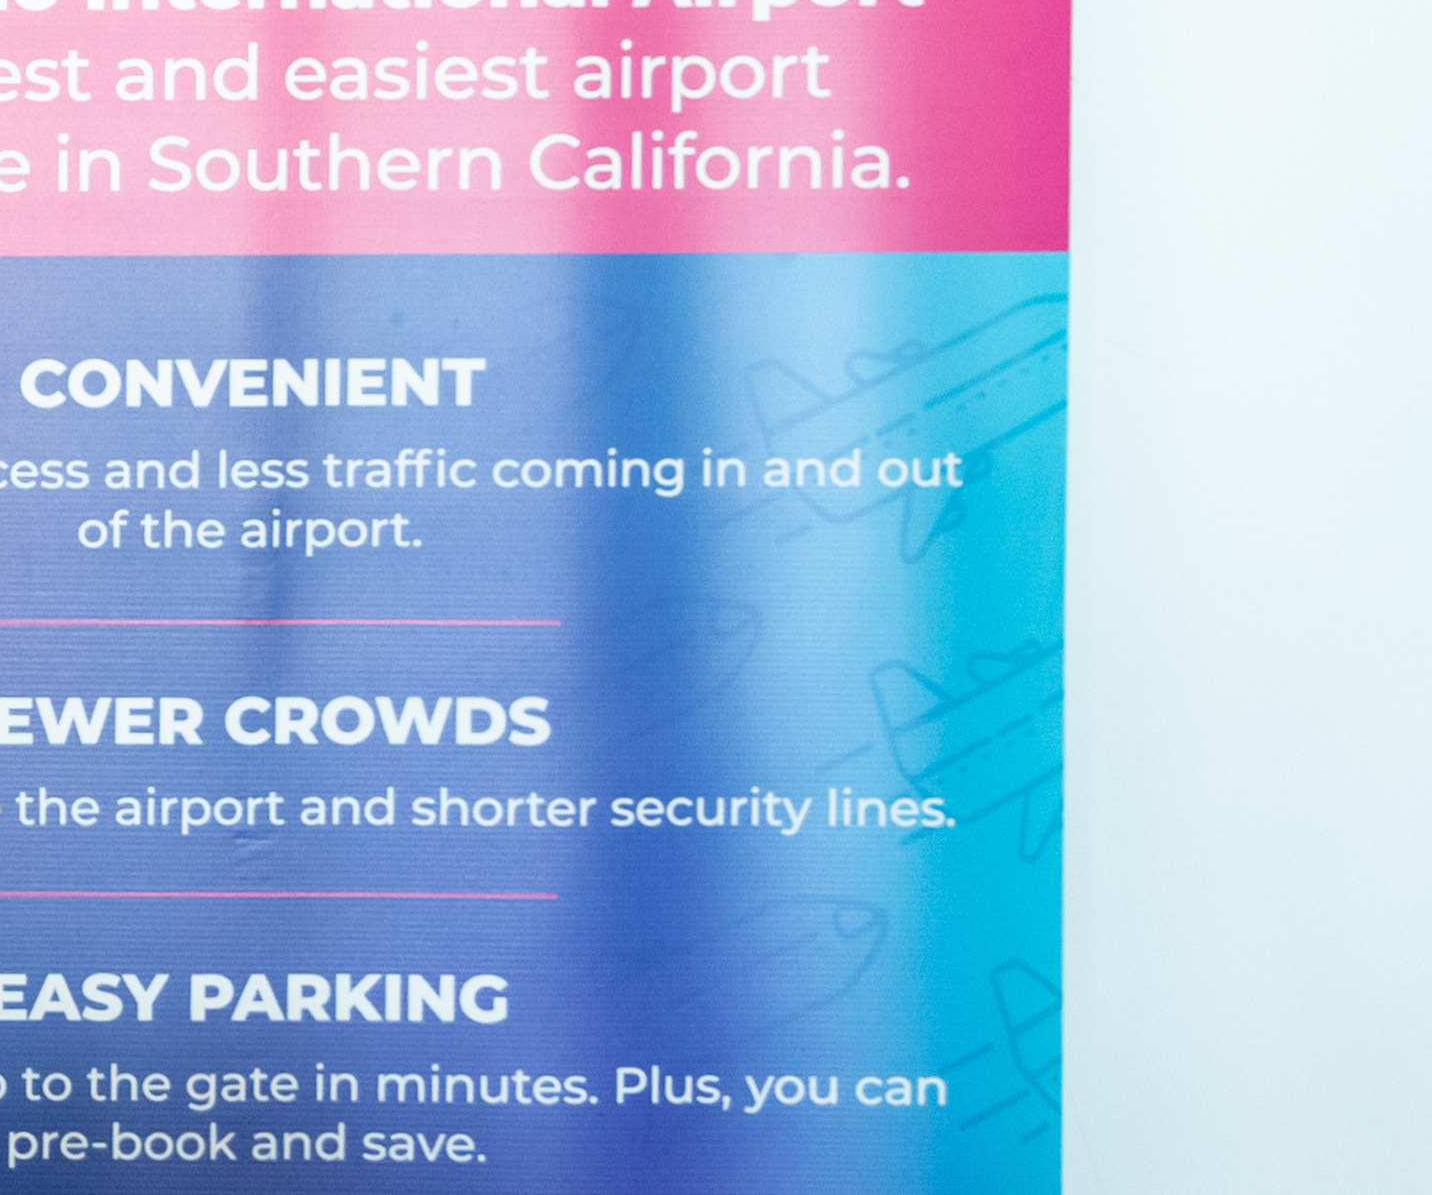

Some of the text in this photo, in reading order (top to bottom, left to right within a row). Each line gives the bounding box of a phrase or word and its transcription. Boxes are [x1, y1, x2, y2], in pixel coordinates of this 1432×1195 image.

[116, 42, 257, 101] and
[285, 41, 549, 100] easiest
[574, 38, 831, 113] airport
[58, 134, 119, 191] in
[150, 133, 501, 191] Southern
[530, 130, 910, 190] California.
[21, 358, 486, 408] CONVENIENT
[105, 449, 200, 489] and
[219, 449, 310, 489] less
[322, 448, 477, 488] traffic
[492, 447, 685, 498] coming
[702, 446, 746, 487] in
[763, 448, 862, 487] and
[877, 452, 964, 488] out
[78, 508, 422, 558] of the airport.
[225, 696, 551, 746] CROWDS
[15, 786, 100, 827] the
[115, 786, 286, 837] airport
[300, 786, 395, 826] and
[411, 787, 597, 827] shorter
[610, 786, 813, 837] security
[828, 786, 956, 829] lines.
[190, 973, 508, 1024] PARKING
[21, 1067, 72, 1102] to
[86, 1062, 172, 1102] the
[186, 1067, 299, 1113] gate
[316, 1062, 359, 1102] in
[377, 1063, 598, 1105] minutes.
[616, 1065, 731, 1111] Plus,
[743, 1074, 839, 1114] you
[855, 1075, 948, 1107] can
[8, 1121, 486, 1169] pre-book and save.
